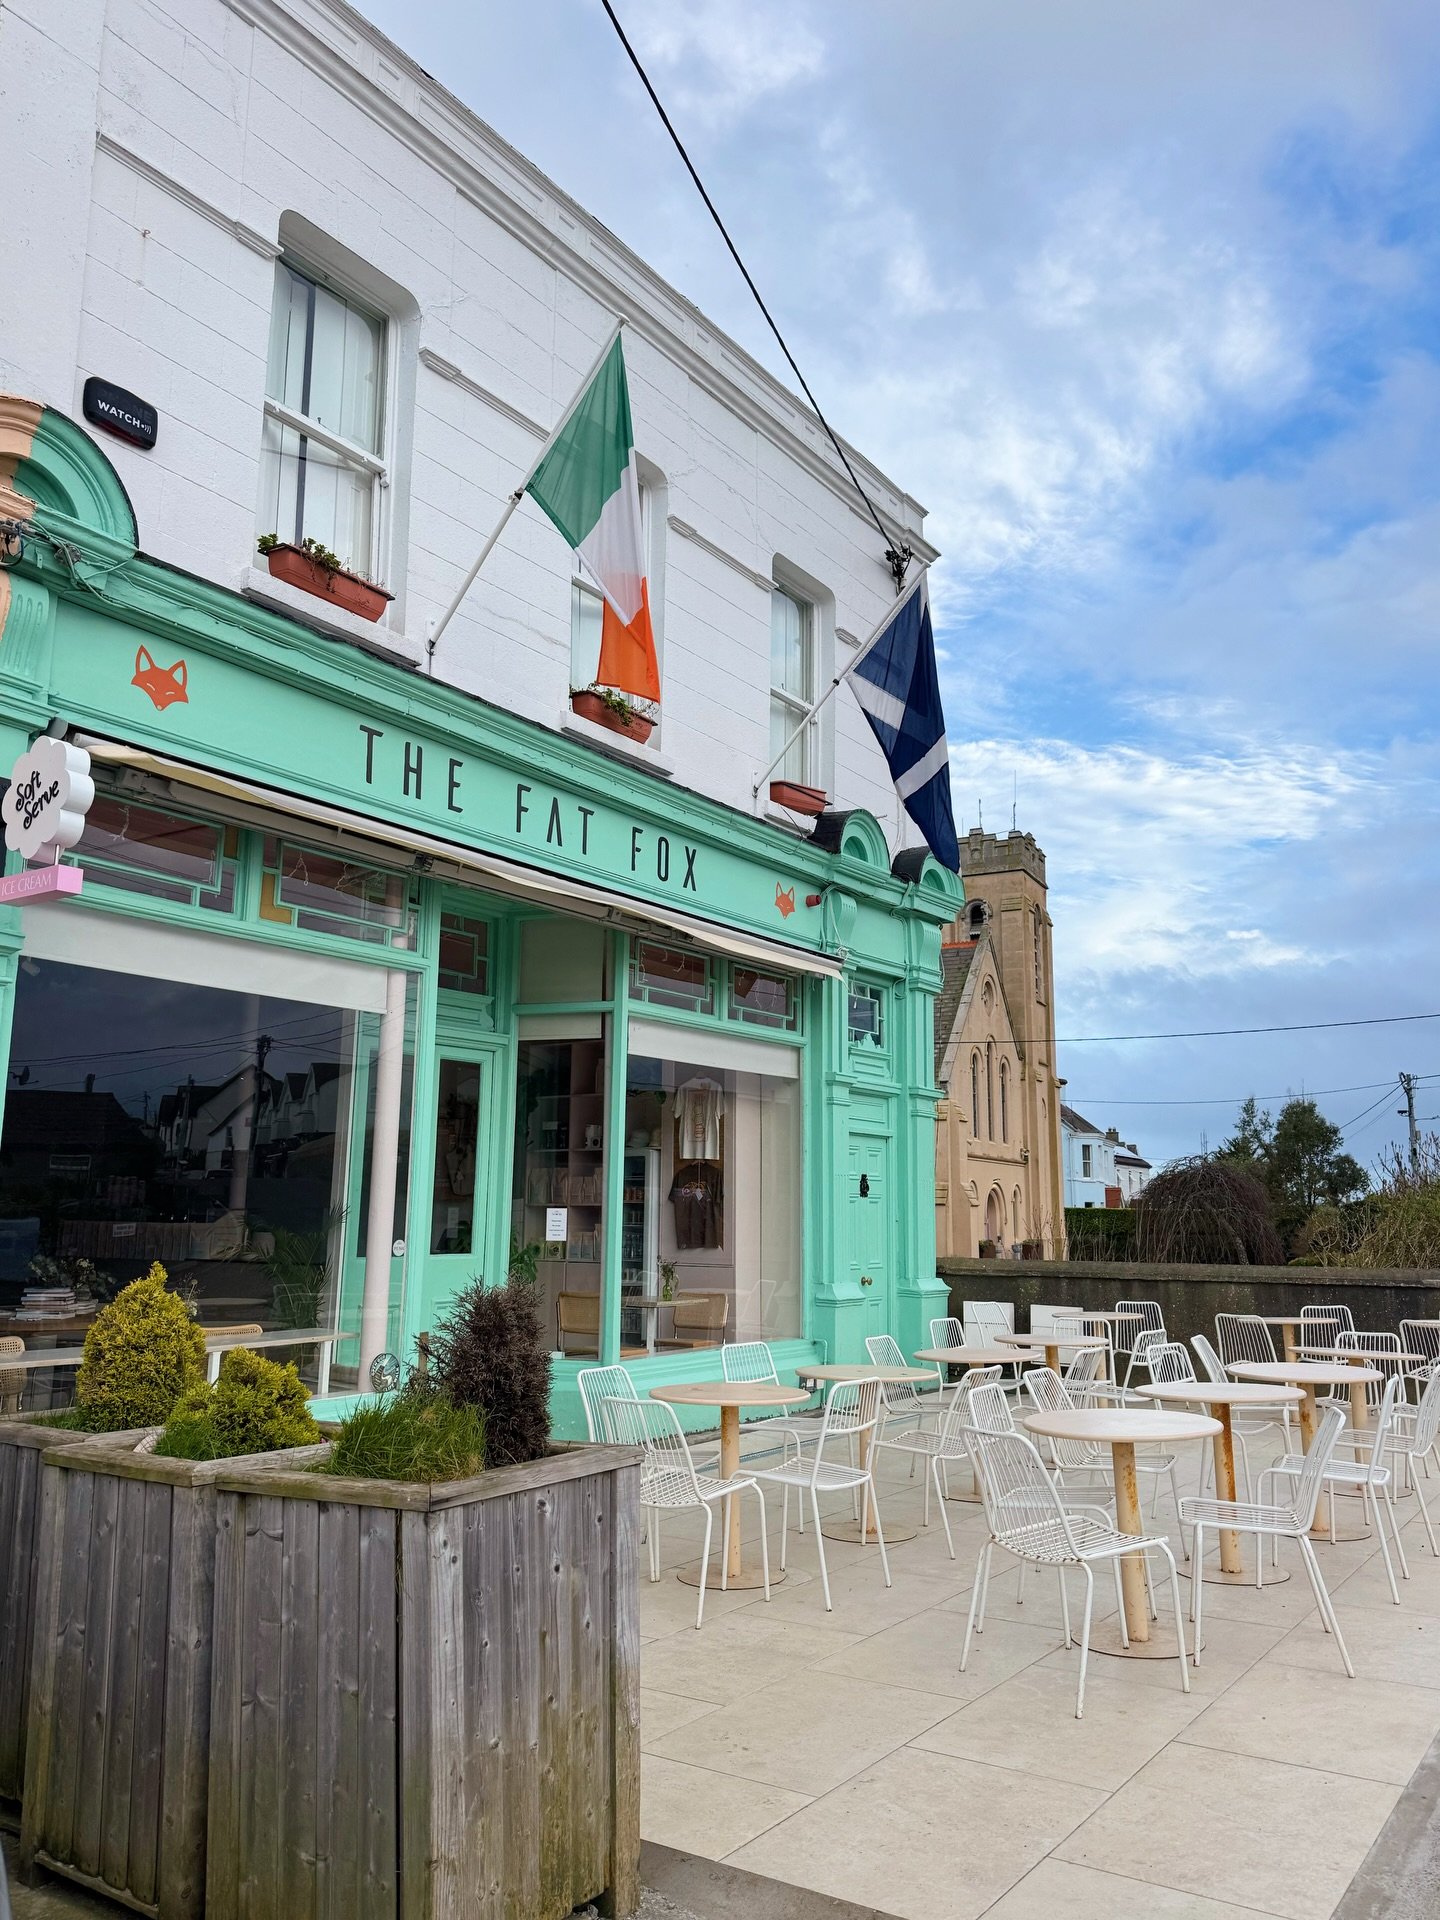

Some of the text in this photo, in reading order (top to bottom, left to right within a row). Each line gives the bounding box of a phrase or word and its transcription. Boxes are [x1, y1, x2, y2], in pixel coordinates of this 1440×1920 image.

[98, 399, 141, 428] WATCH
[16, 770, 42, 812] Soft
[23, 779, 59, 830] Serve
[359, 724, 697, 892] THE FAT FOX
[1, 873, 52, 896] ICE CREAM
